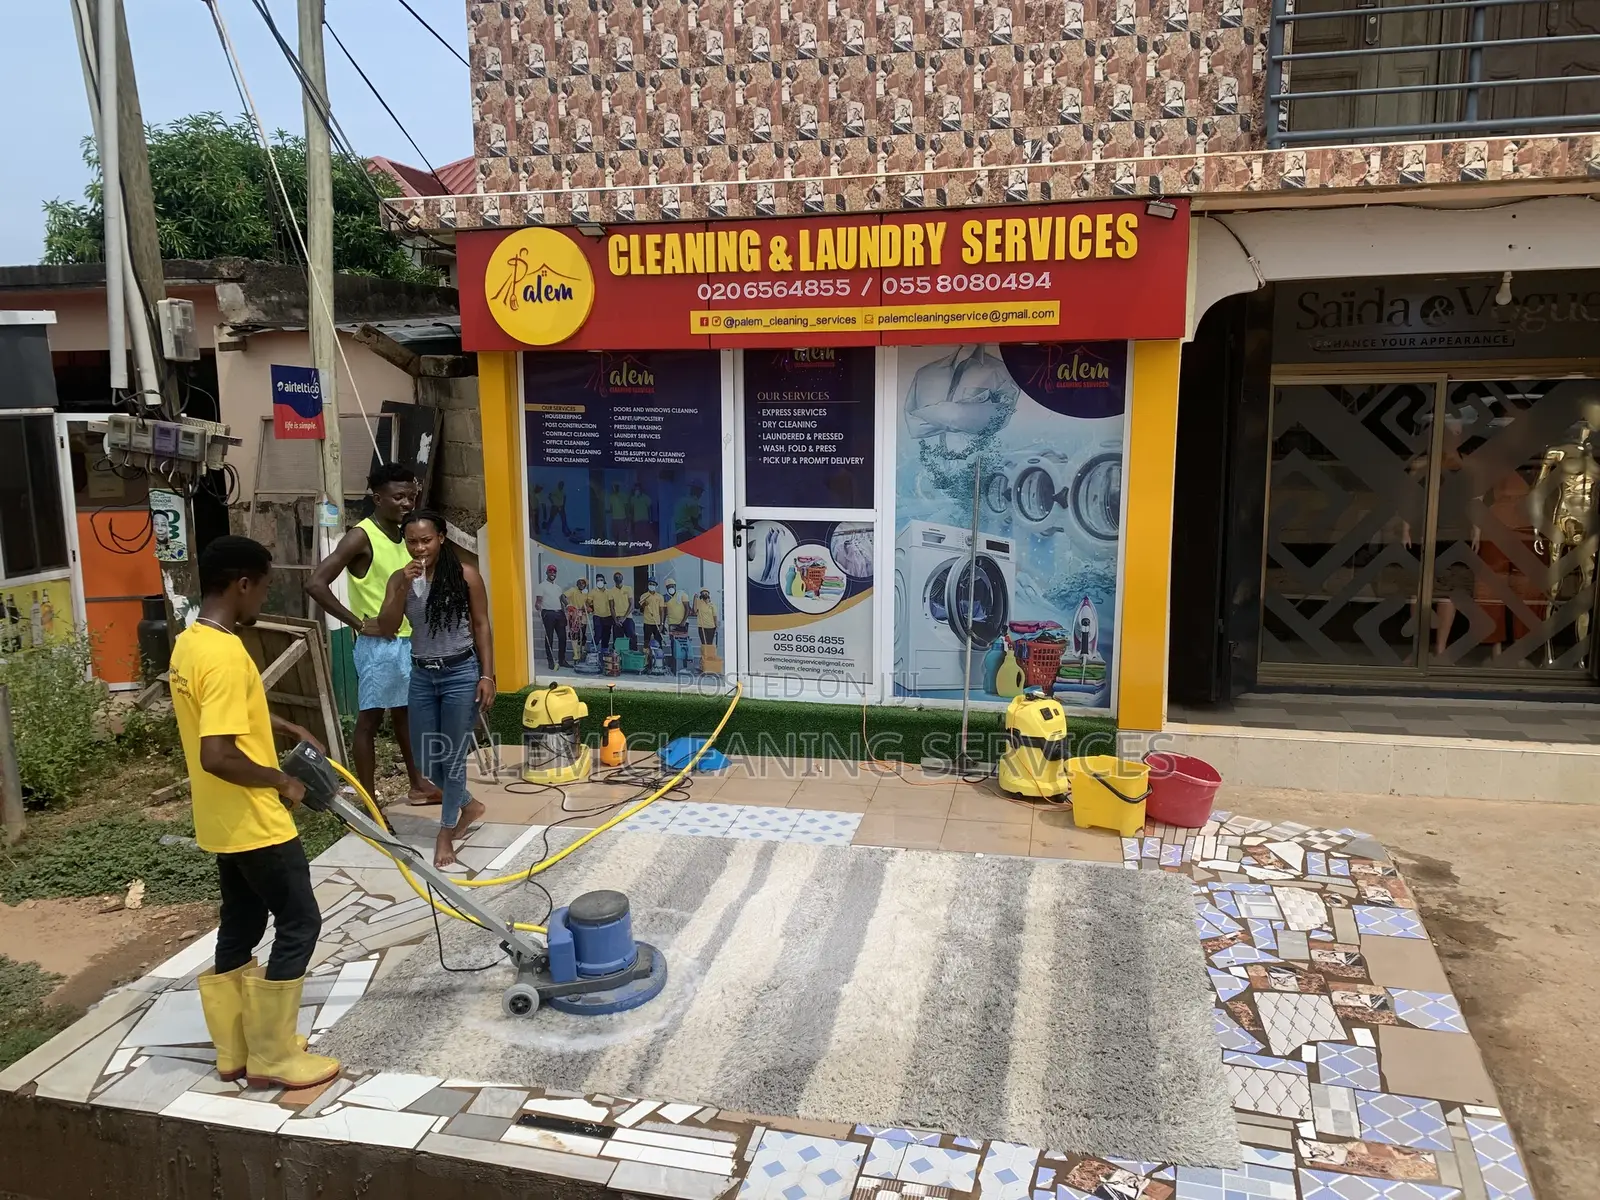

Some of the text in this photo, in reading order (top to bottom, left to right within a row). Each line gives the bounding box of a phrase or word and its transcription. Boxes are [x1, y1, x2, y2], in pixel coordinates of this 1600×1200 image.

[607, 213, 1139, 277] CLEANING & LAUNDRY SERVICES
[936, 271, 1052, 293] 8080494
[878, 309, 1055, 325] palemcleaningservice@gmail.com
[1381, 335, 1417, 348] YOUR
[1420, 334, 1509, 347] APPEARANCE
[757, 391, 830, 400] OUR SERVICES
[284, 421, 294, 431] life
[762, 433, 844, 441] LAUNDERED & PRESSED
[763, 444, 837, 453] WASH, FOLD & PRESS
[763, 456, 780, 464] PICK
[781, 456, 791, 464] UP
[799, 456, 830, 465] PROMPT
[830, 456, 865, 465] DELIVERY
[629, 541, 653, 549] priority
[773, 632, 845, 645] 020 656 4855
[773, 643, 845, 656] 055 808 0494
[763, 657, 855, 668] palemcleaningservice@gmail.com
